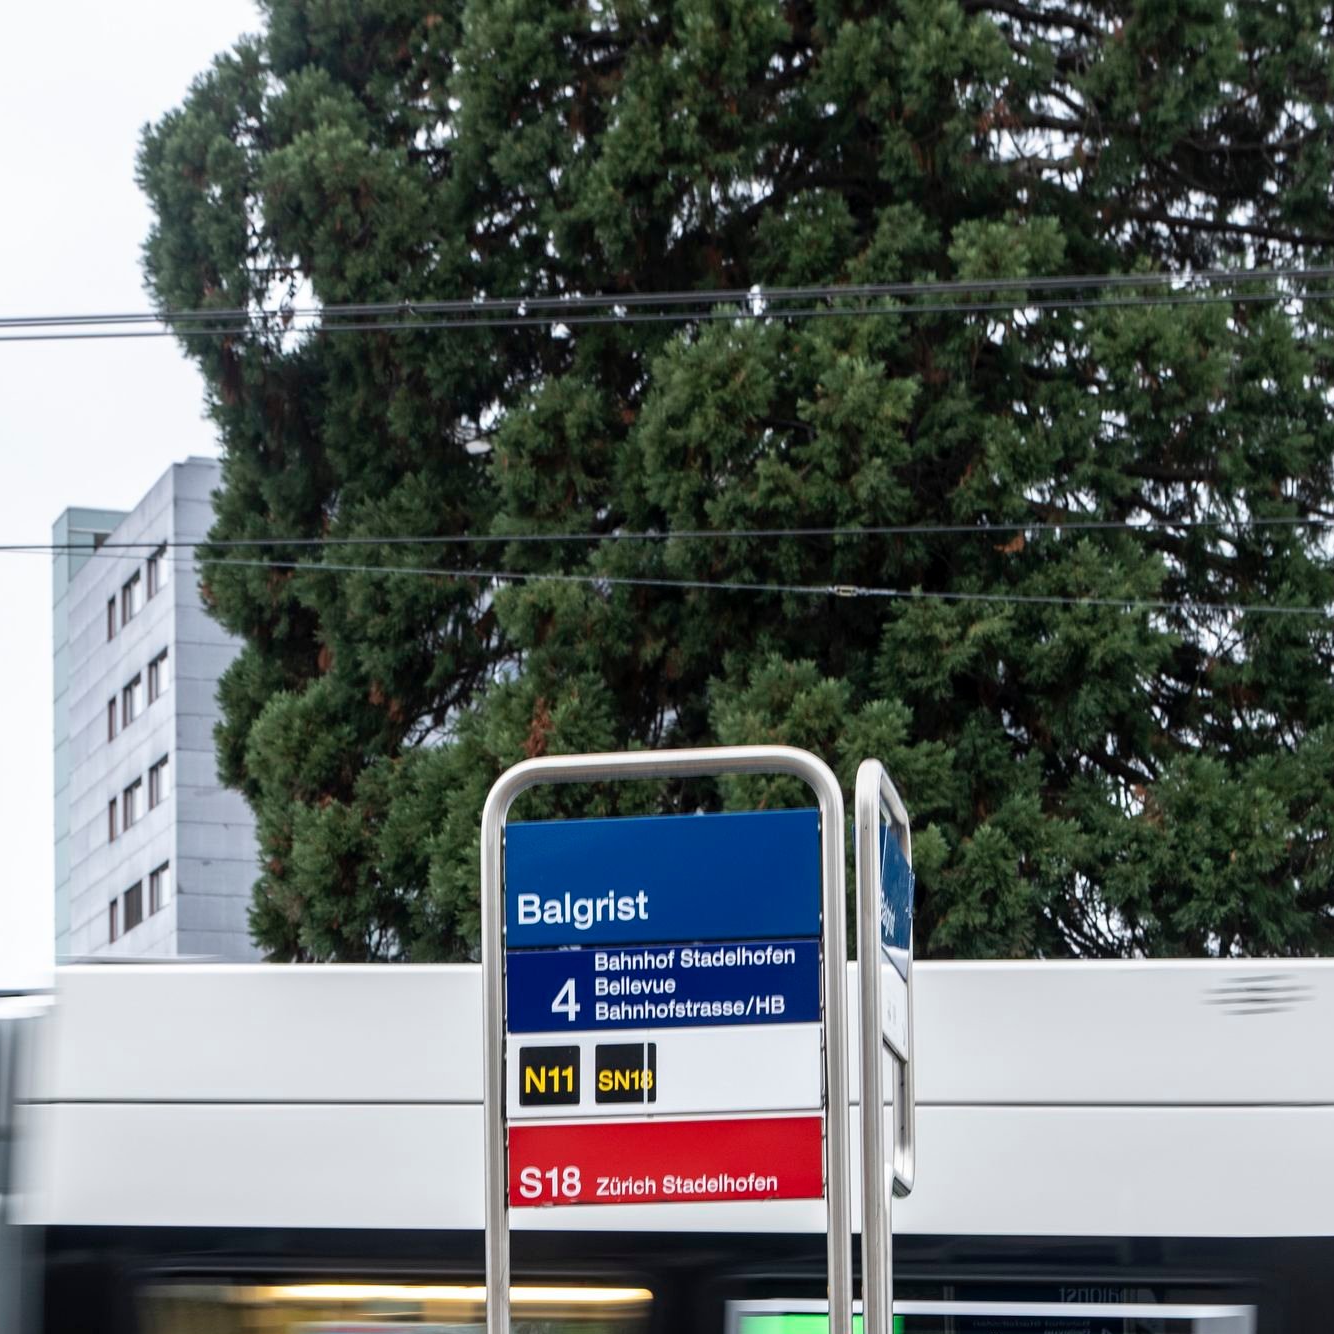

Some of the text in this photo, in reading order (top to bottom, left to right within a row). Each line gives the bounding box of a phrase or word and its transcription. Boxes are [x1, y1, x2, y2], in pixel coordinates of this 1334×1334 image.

[517, 889, 649, 931] Balgrist
[594, 943, 796, 972] Bahnhof Stadelhofen
[551, 977, 581, 1022] 4
[594, 975, 676, 997] Bellevue
[595, 994, 785, 1021] Bahnhofstrasse/HB
[525, 1065, 574, 1094] N11
[598, 1069, 654, 1092] SN18
[519, 1166, 582, 1199] S18
[596, 1172, 778, 1197] Zürich Stadelhofen
